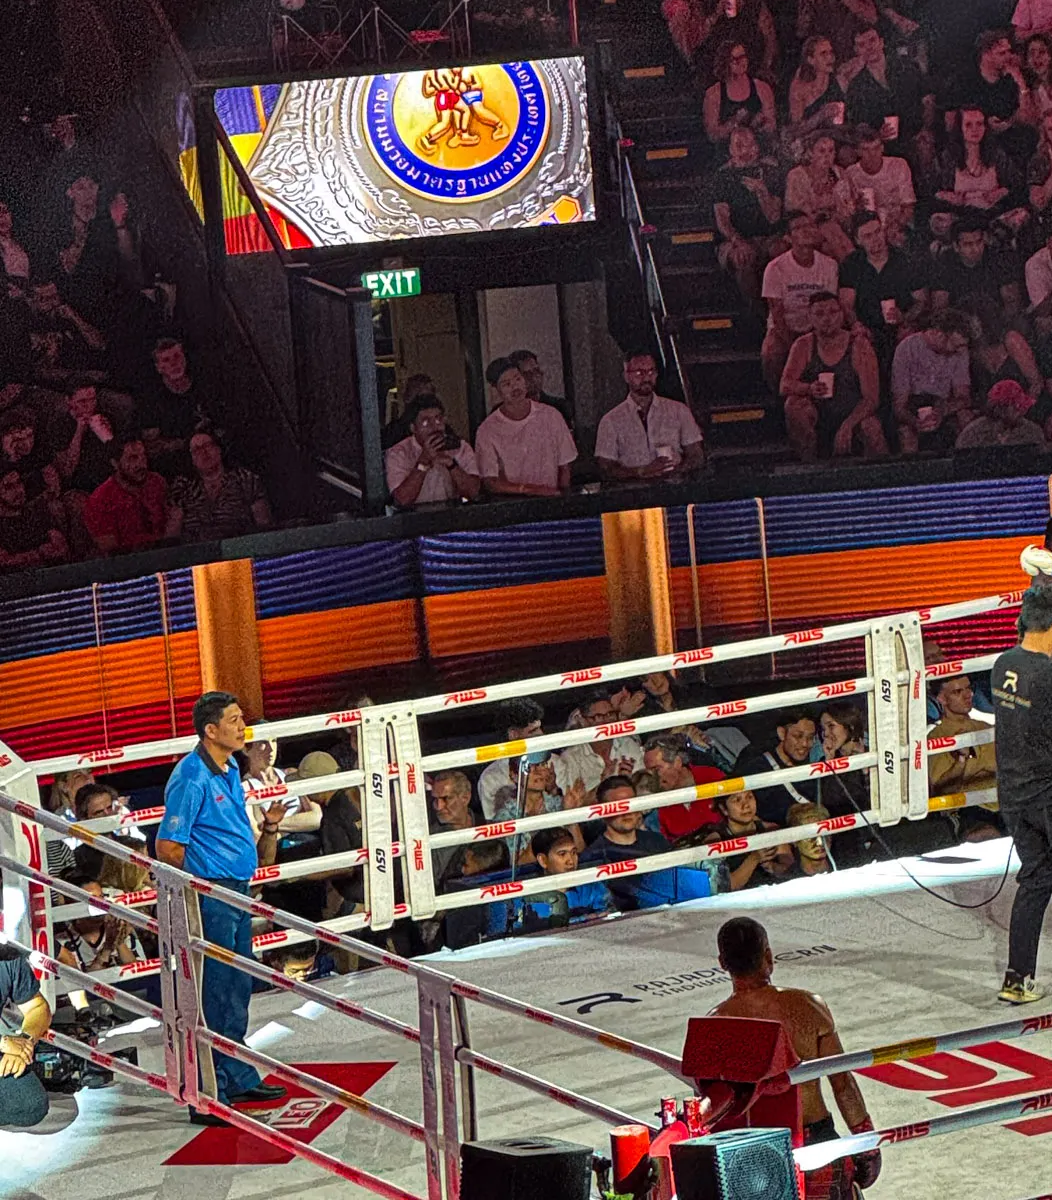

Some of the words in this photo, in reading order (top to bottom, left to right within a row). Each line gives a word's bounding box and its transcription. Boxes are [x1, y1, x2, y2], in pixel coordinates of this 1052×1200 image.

[366, 269, 417, 297] EXIT
[998, 589, 1024, 606] RW
[784, 628, 824, 645] RWS
[672, 648, 714, 666] RWS
[560, 668, 602, 685] RWS
[926, 661, 963, 677] RWS
[444, 689, 487, 706] RWS
[817, 680, 856, 698] RWS
[881, 679, 892, 703] GSV
[706, 701, 747, 718] RWS
[594, 721, 636, 738] RWS
[809, 758, 849, 776] RWS
[884, 750, 895, 775] GSV
[372, 772, 384, 798] GSV
[406, 762, 417, 795] RWS
[246, 784, 288, 800] RWS
[588, 801, 630, 819] RWS
[473, 821, 516, 839] RWS
[817, 814, 856, 833] RWS
[413, 838, 424, 871] RWS
[707, 837, 749, 856] RWS
[375, 848, 387, 874] GSV
[596, 860, 637, 878] RWS
[480, 881, 524, 899] RWS
[876, 1121, 931, 1146] RWS
